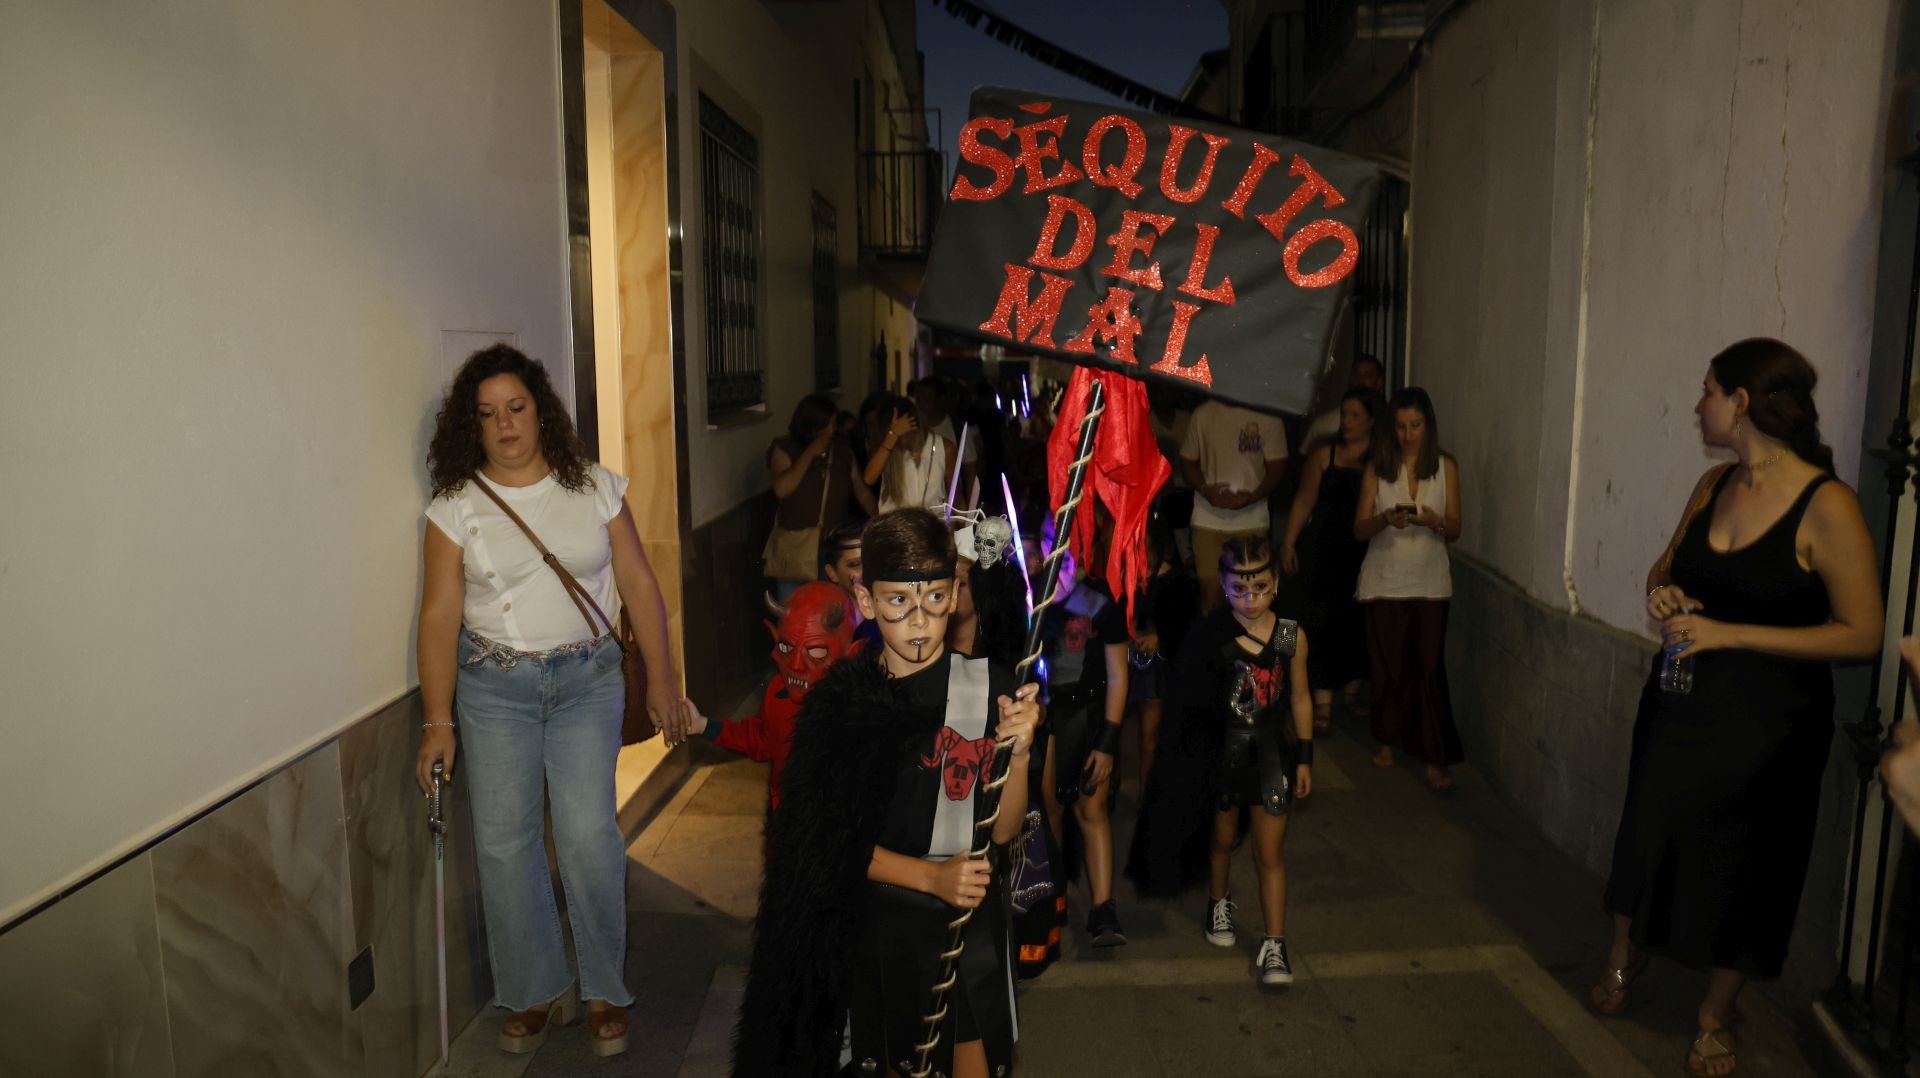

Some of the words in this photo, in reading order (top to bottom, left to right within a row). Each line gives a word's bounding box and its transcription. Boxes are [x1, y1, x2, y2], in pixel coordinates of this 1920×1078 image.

[949, 101, 1360, 289] SÉQUITO
[1027, 194, 1237, 305] DEL
[978, 262, 1213, 388] MAL
